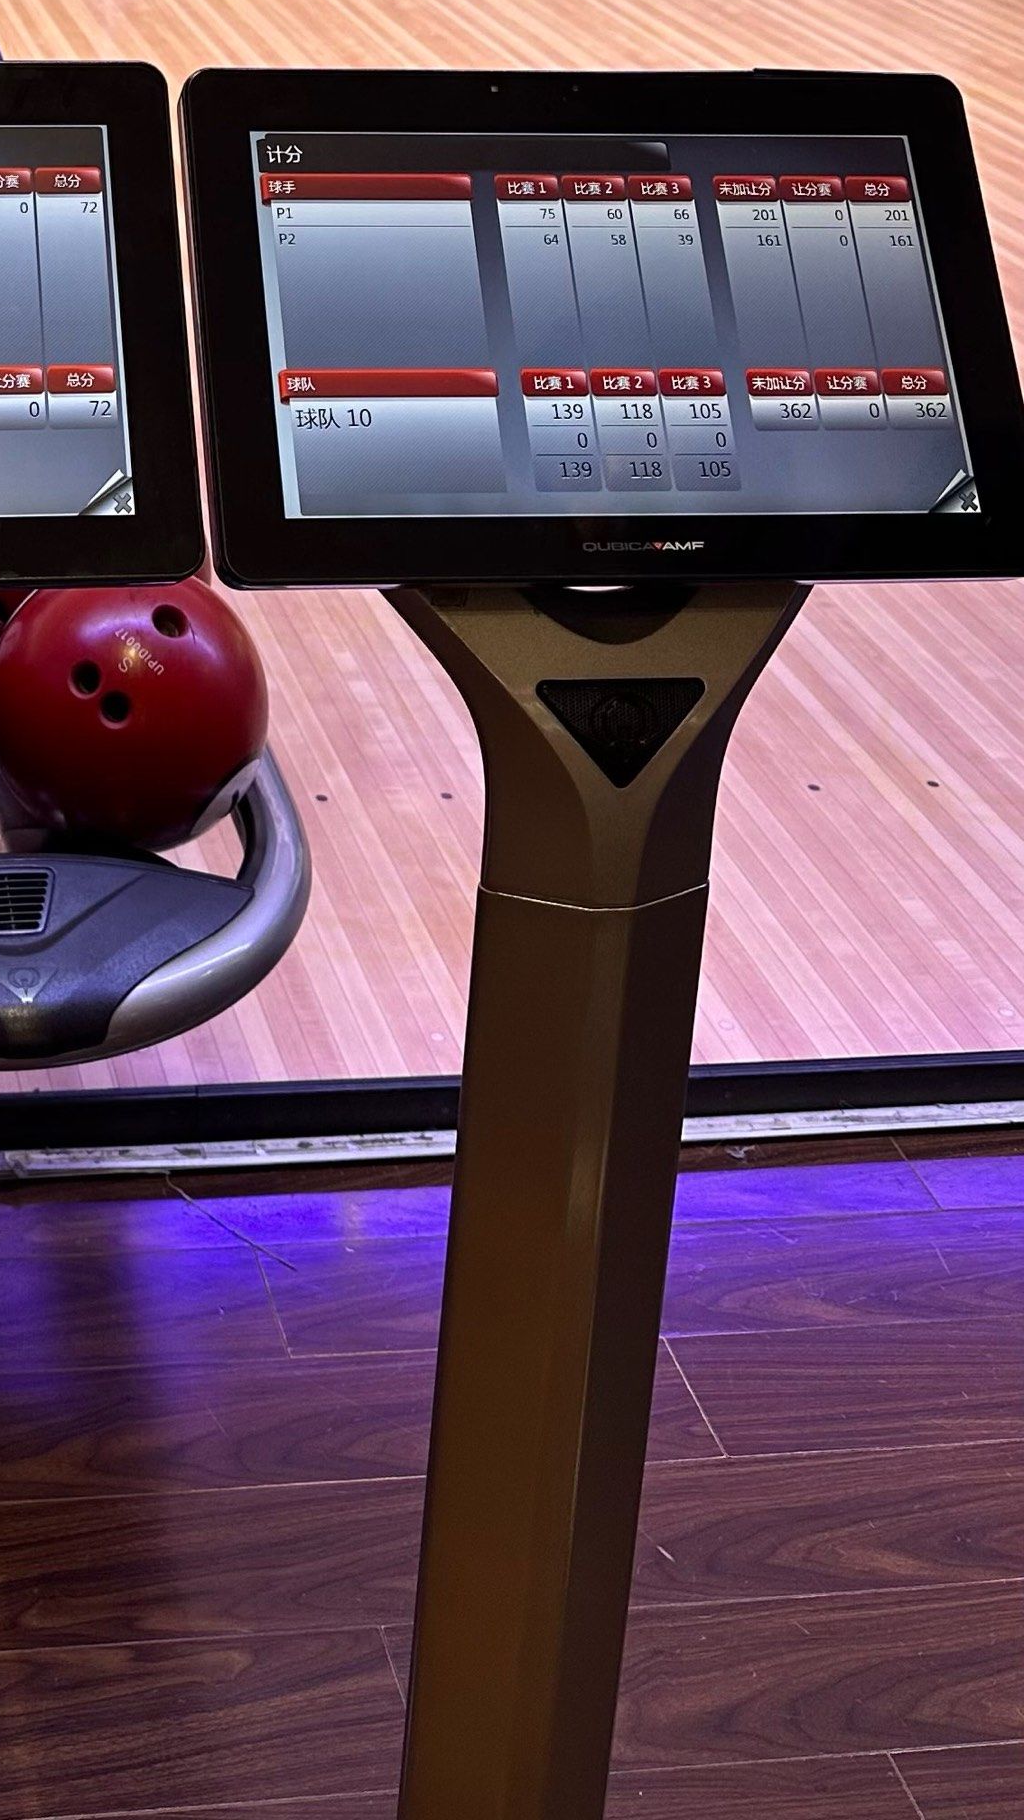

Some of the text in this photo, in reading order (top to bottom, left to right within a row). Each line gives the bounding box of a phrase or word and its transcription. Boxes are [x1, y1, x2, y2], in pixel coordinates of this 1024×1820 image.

[266, 145, 303, 164] 计分
[54, 174, 82, 189] 总分
[269, 180, 296, 194] 球手
[507, 181, 547, 195] 比赛 1
[574, 181, 613, 195] 比赛 2
[640, 181, 679, 195] 比赛 3
[719, 182, 771, 197] 未加让分
[791, 182, 831, 197] 让分赛
[864, 182, 890, 197] 总分
[20, 202, 28, 215] 0
[80, 201, 98, 213] 72
[277, 207, 293, 219] P1
[539, 209, 555, 220] 75
[607, 209, 623, 220] 60
[674, 209, 690, 220] 66
[752, 209, 777, 222] 201
[835, 209, 843, 222] 0
[885, 210, 909, 222] 201
[279, 233, 296, 245] P2
[543, 234, 559, 246] 64
[610, 234, 626, 246] 58
[678, 234, 693, 246] 39
[757, 234, 782, 247] 161
[839, 235, 848, 247] 0
[890, 234, 914, 247] 161
[67, 373, 95, 388] 总分
[287, 377, 315, 392] 球队
[534, 375, 574, 390] 比赛 1
[602, 375, 643, 390] 比赛 2
[671, 375, 711, 390] 比赛 3
[752, 376, 806, 391] 未加让分
[826, 376, 868, 391] 让分赛
[901, 375, 928, 390] 总分
[29, 402, 40, 418] 0
[89, 401, 111, 417] 72
[552, 404, 584, 420] 139
[620, 404, 653, 420] 118
[689, 404, 722, 420] 105
[780, 403, 813, 419] 362
[869, 403, 880, 419] 0
[915, 403, 947, 419] 362
[296, 409, 372, 430] 球队 10
[577, 432, 588, 449] 0
[646, 432, 657, 449] 0
[715, 432, 727, 449] 0
[559, 462, 592, 478] 139
[629, 462, 662, 478] 118
[698, 462, 731, 478] 105
[118, 656, 133, 673] S
